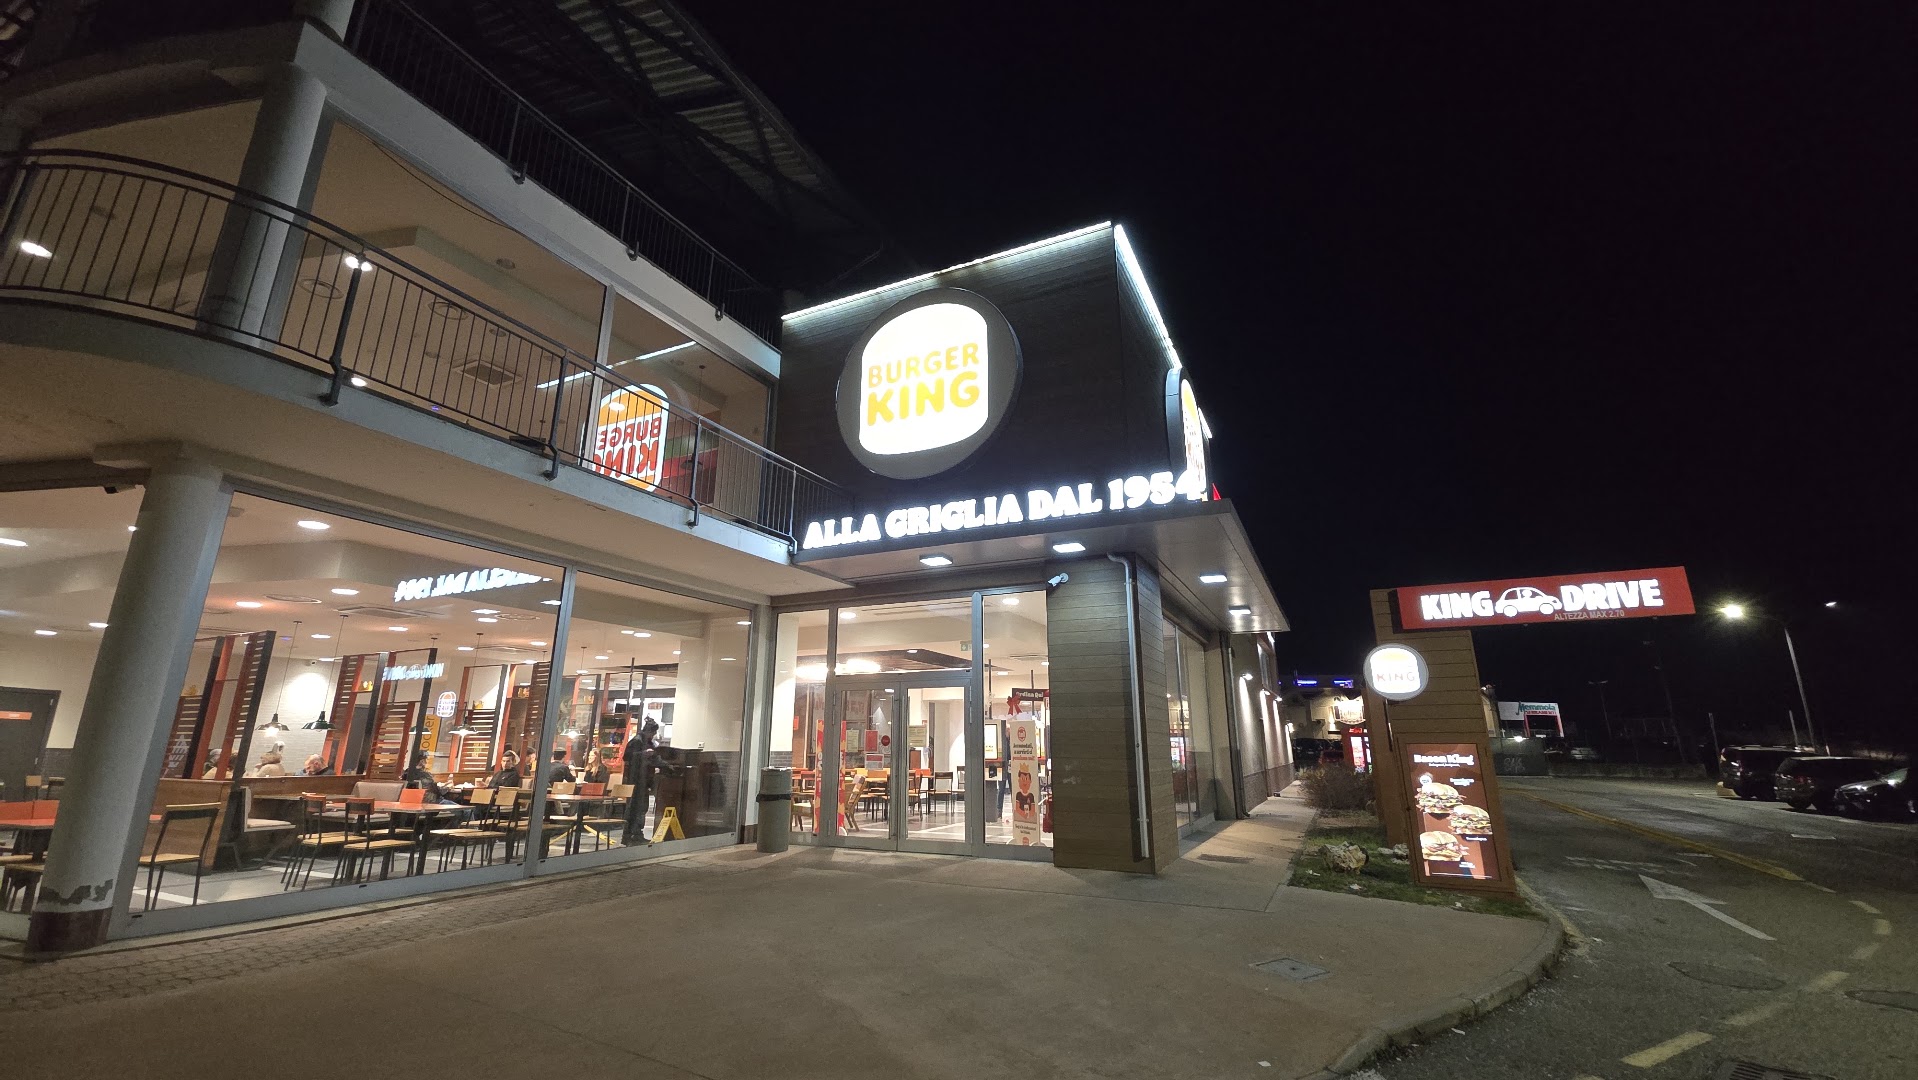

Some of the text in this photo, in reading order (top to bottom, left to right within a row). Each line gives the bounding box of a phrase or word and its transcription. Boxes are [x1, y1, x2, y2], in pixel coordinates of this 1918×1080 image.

[868, 342, 979, 389] BURGER
[867, 371, 980, 427] KING
[803, 468, 1205, 550] ALLA GRIGLIA DAL 1954
[1420, 579, 1664, 620] KING DRIVE
[1554, 609, 1625, 621] ALTEZZA MAX 2.70
[1376, 671, 1416, 682] KING
